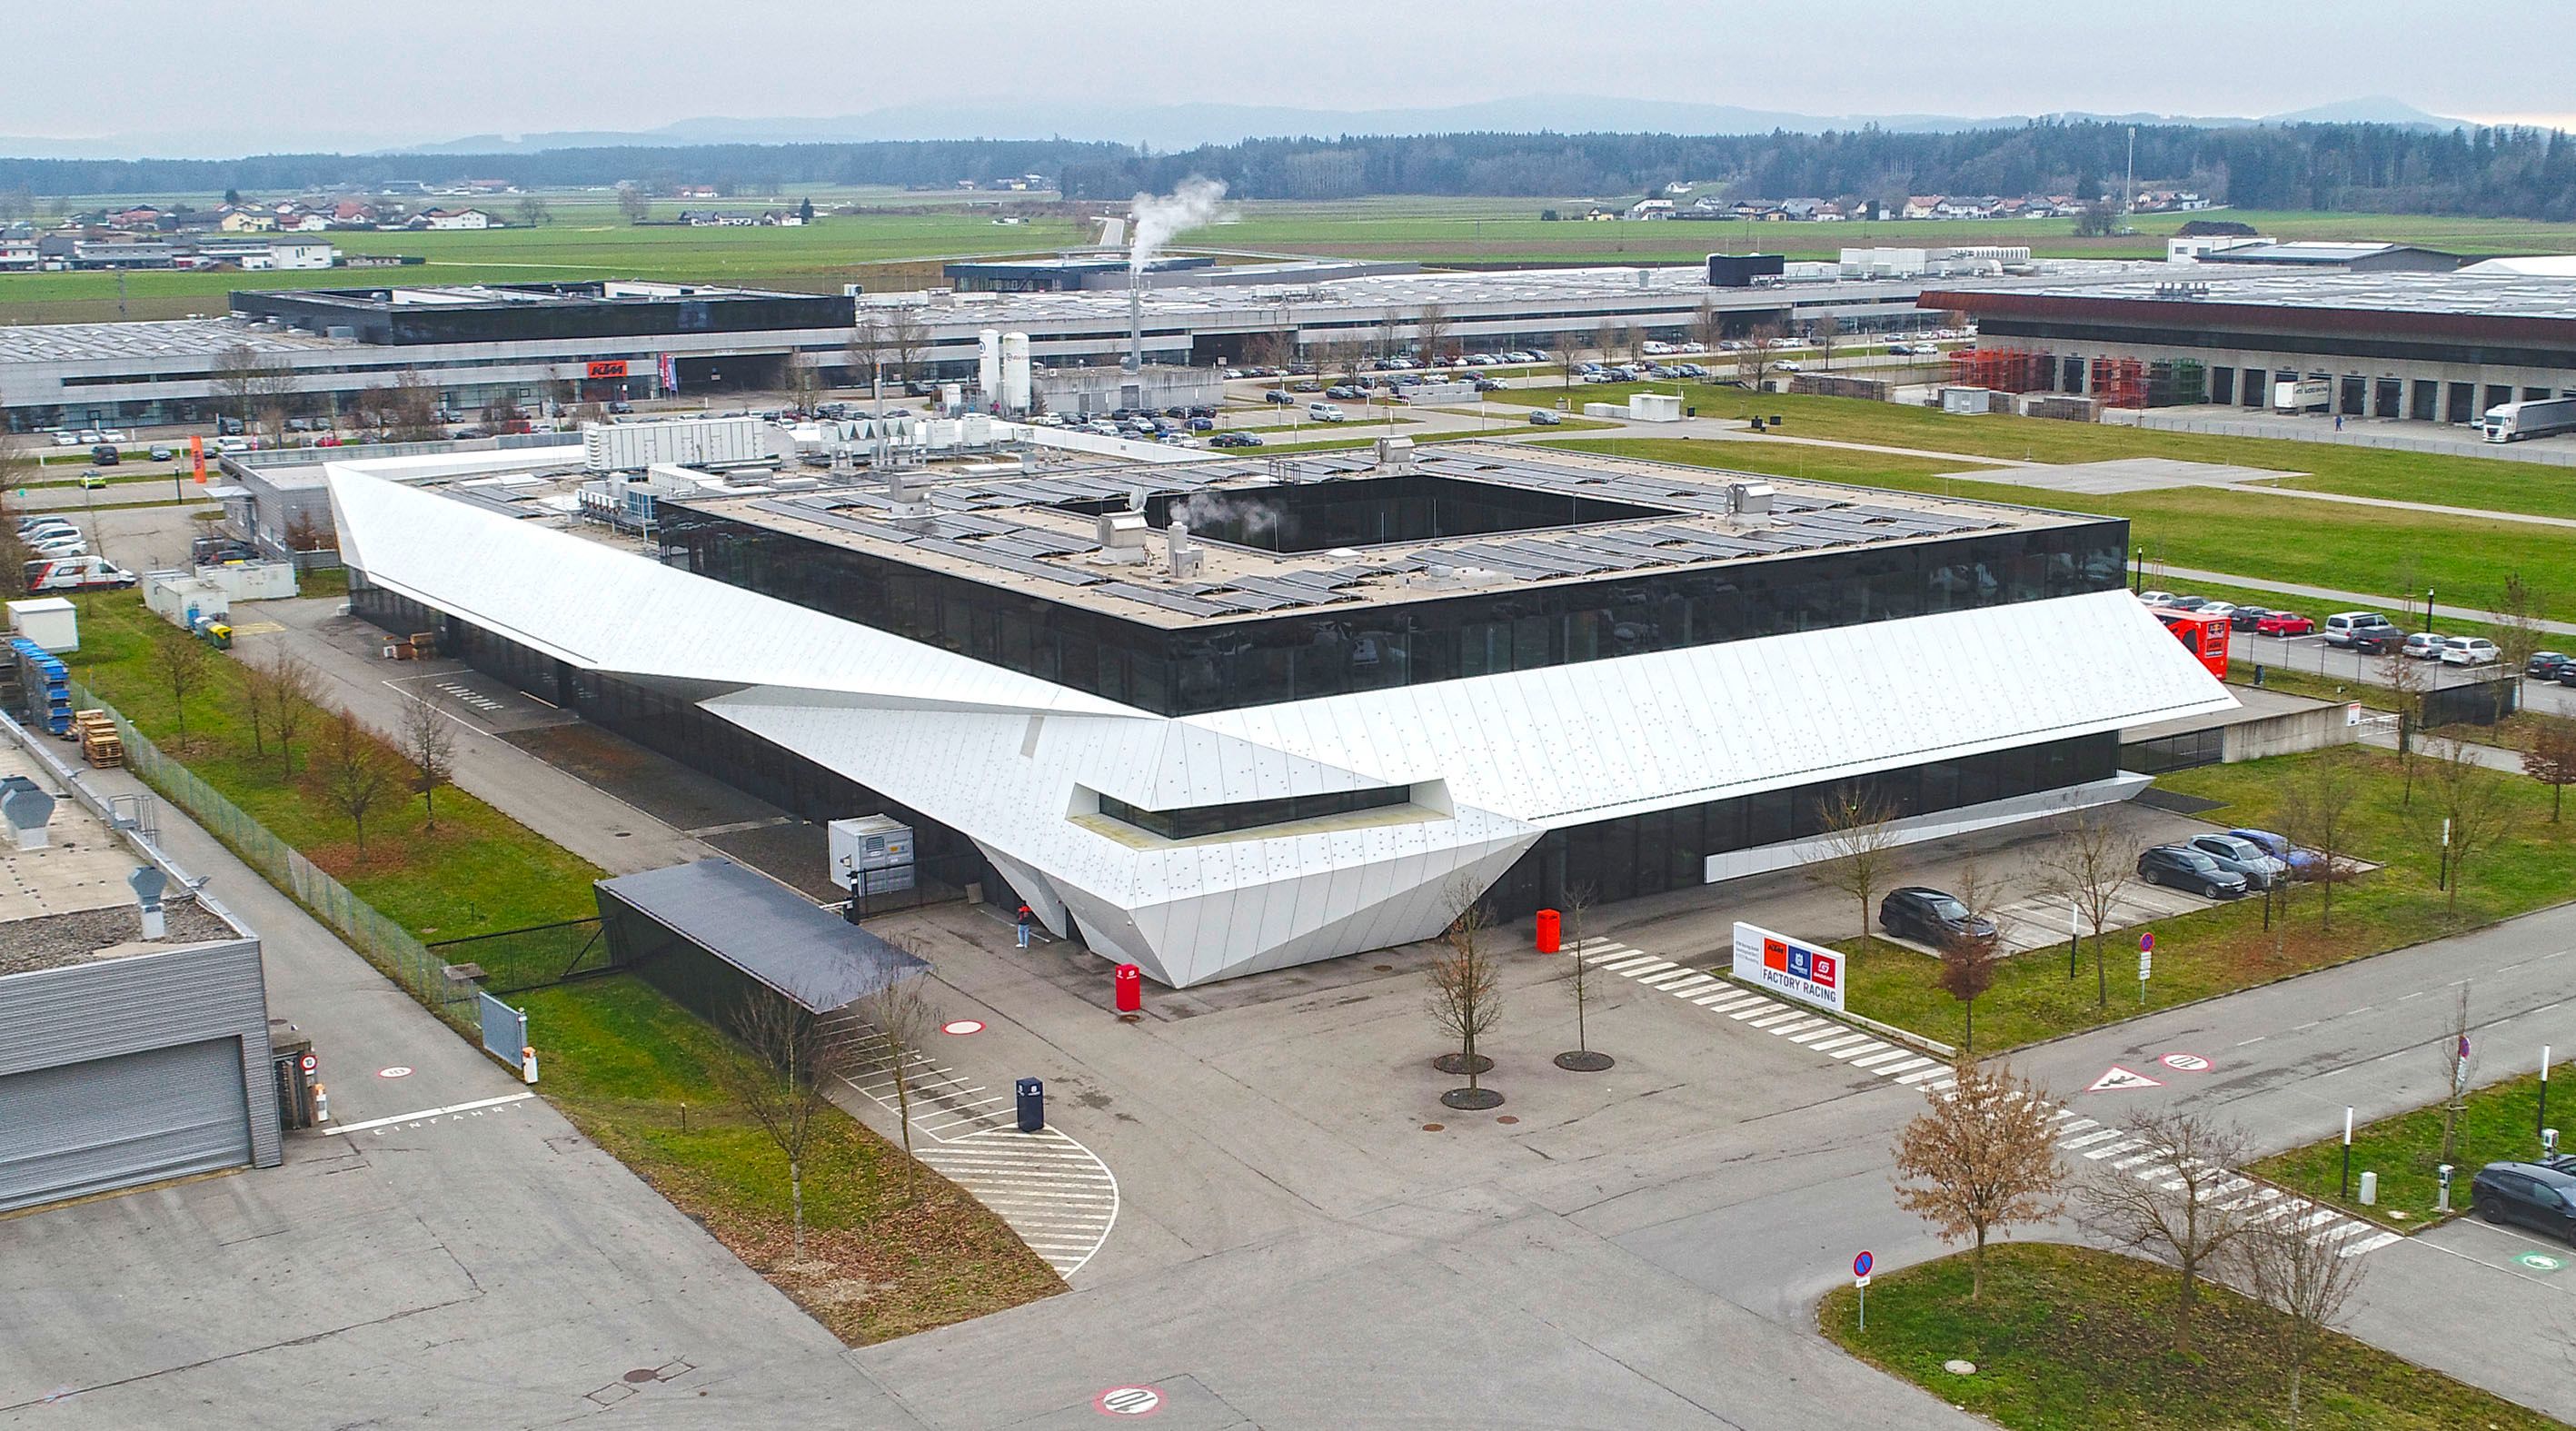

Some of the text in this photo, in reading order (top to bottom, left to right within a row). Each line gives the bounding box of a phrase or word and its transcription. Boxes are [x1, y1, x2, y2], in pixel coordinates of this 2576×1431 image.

[592, 363, 623, 375] KTM
[1763, 969, 1801, 991] FACTORY
[1803, 982, 1836, 1003] RACING
[373, 1102, 522, 1136] EINFAHRT
[1105, 1391, 1156, 1411] 10
